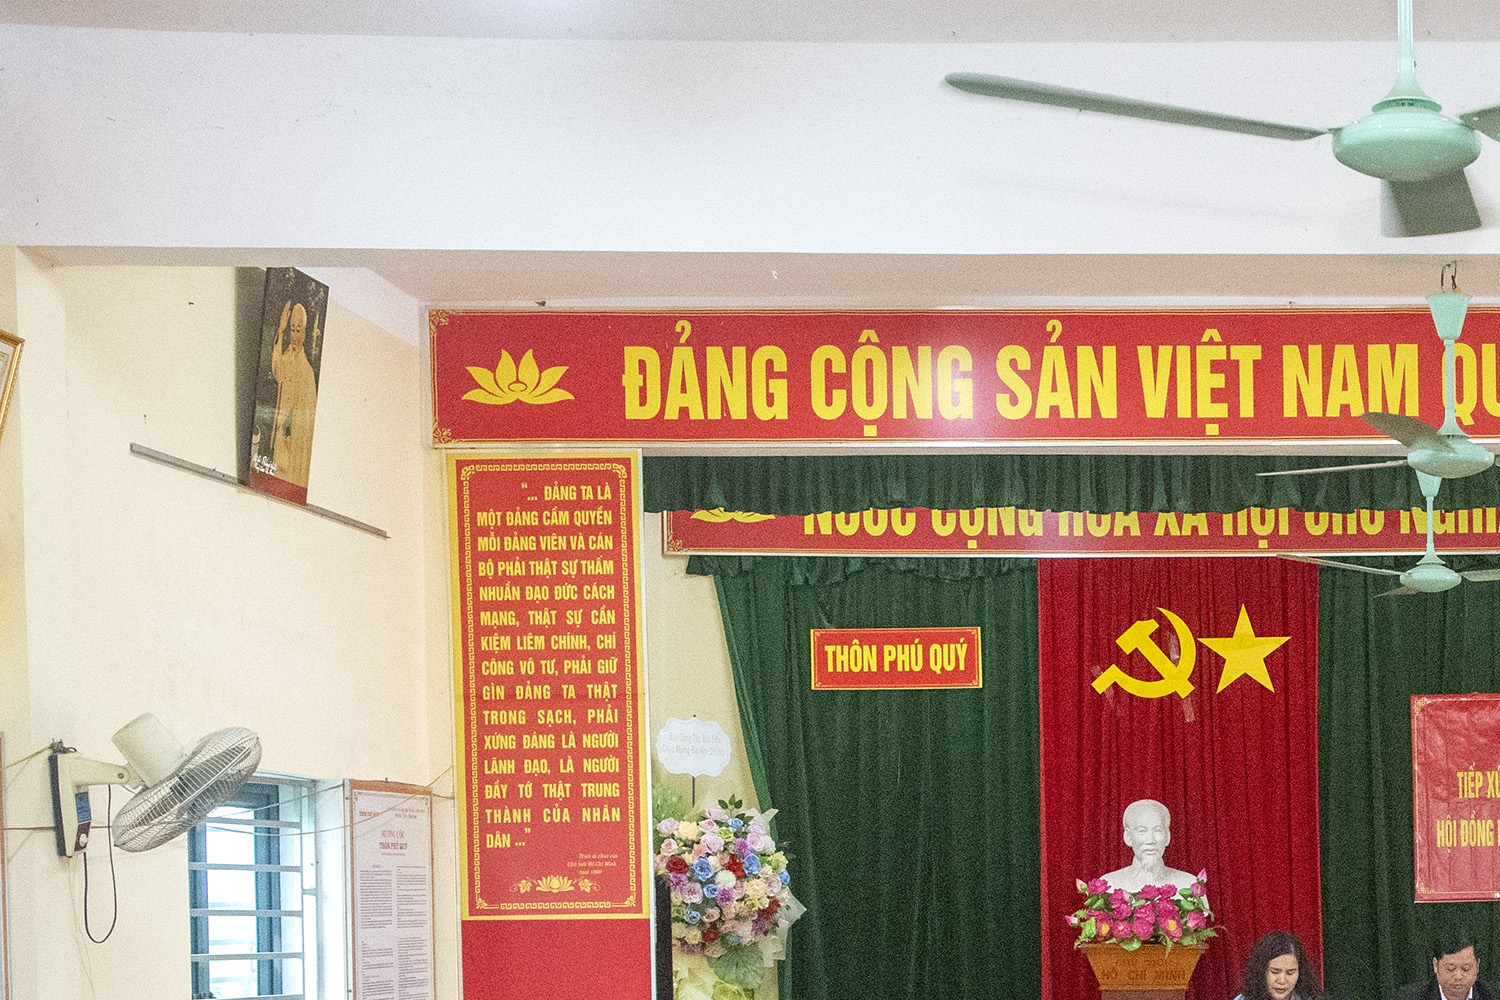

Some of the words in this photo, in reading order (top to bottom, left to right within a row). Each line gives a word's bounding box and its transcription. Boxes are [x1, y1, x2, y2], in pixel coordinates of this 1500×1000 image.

[623, 323, 788, 420] ĐẢNG
[812, 331, 972, 437] CỘNG
[996, 321, 1117, 420] SẢN
[1138, 330, 1261, 435] VIỆT
[1284, 344, 1418, 417] NAM
[544, 482, 576, 500] ĐẢNG
[580, 486, 593, 500] TA
[598, 483, 611, 500] LÀ
[477, 509, 502, 529] MỘT
[506, 507, 538, 526] ĐẢNG
[543, 506, 569, 525] CẦM
[574, 506, 612, 526] QUYỀN
[478, 532, 500, 551] MỖI
[504, 532, 536, 550] ĐẢNG
[540, 533, 566, 550] VIÊN
[570, 533, 585, 550] VÀ
[589, 532, 613, 550] CÁN
[478, 558, 494, 579] BỘ
[498, 557, 525, 576] PHẢI
[529, 558, 558, 578] THẬT
[562, 559, 578, 578] SỰ
[580, 556, 614, 574] THẤM
[480, 582, 520, 601] NHUẦN
[525, 586, 549, 603] ĐẠO
[554, 583, 578, 600] ĐỨC
[583, 582, 614, 600] CÁCH
[825, 639, 877, 672] THÔN
[884, 638, 922, 671] PHÚ
[930, 638, 967, 674] QUÝ
[484, 732, 516, 750] XỨNG
[523, 732, 555, 749] ĐÁNG
[562, 731, 576, 748] LÀ
[582, 730, 618, 748] NGƯỜI
[484, 757, 515, 774] LÃNH
[524, 759, 550, 776] ĐẠO,
[560, 756, 574, 773] LÀ
[583, 755, 619, 773] NGƯỜI
[485, 780, 508, 799] ĐẦY
[518, 781, 532, 798] TỚ
[542, 780, 571, 801] THẬT
[581, 782, 620, 797] TRUNG
[1457, 762, 1483, 798] TIẾP
[485, 806, 531, 823] THÀNH
[543, 804, 570, 822] CỦA
[582, 804, 620, 822] NHÂN
[486, 831, 510, 848] DÂN
[1436, 815, 1456, 852] HỘI
[1460, 810, 1494, 847] ĐỒNG
